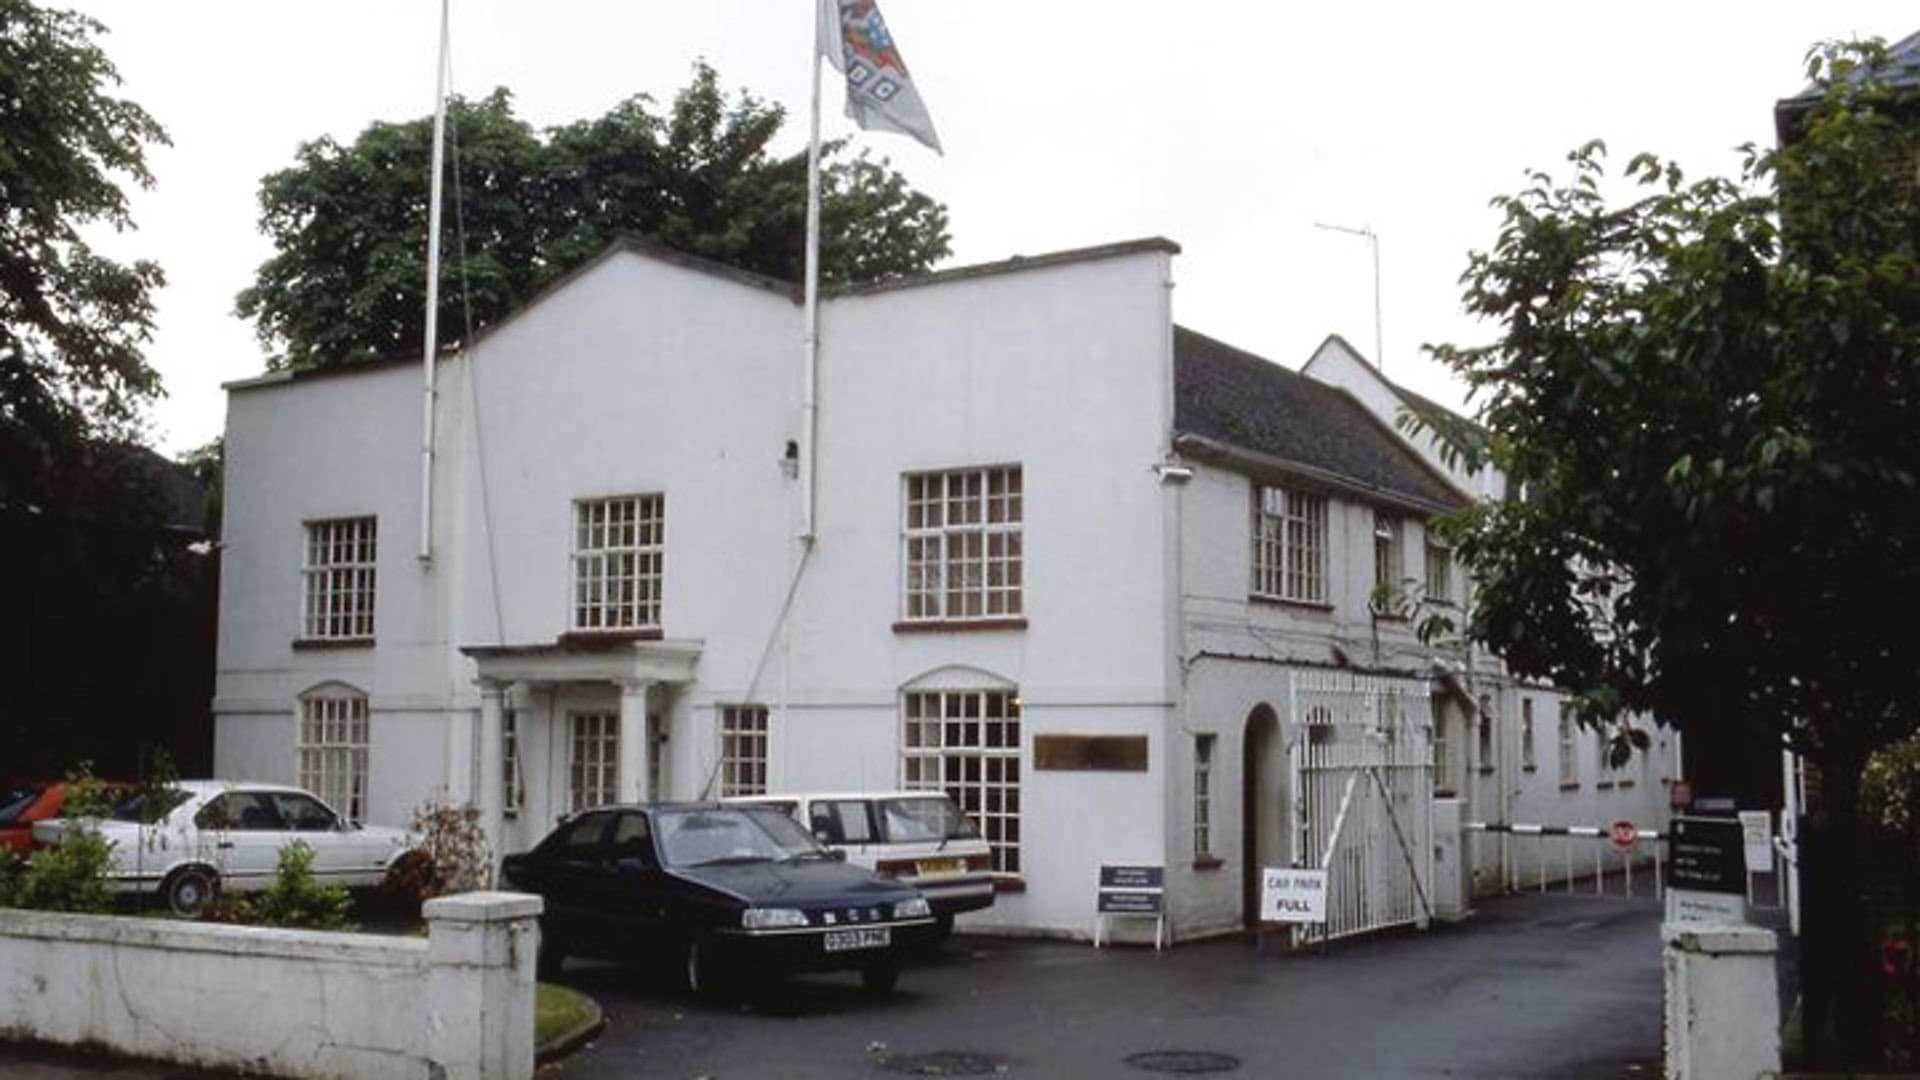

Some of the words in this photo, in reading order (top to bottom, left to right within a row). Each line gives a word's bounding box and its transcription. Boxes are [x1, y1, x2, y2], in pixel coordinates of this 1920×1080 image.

[1268, 877, 1290, 889] CAR
[1293, 878, 1322, 890] PARK
[1276, 898, 1311, 913] FULL
